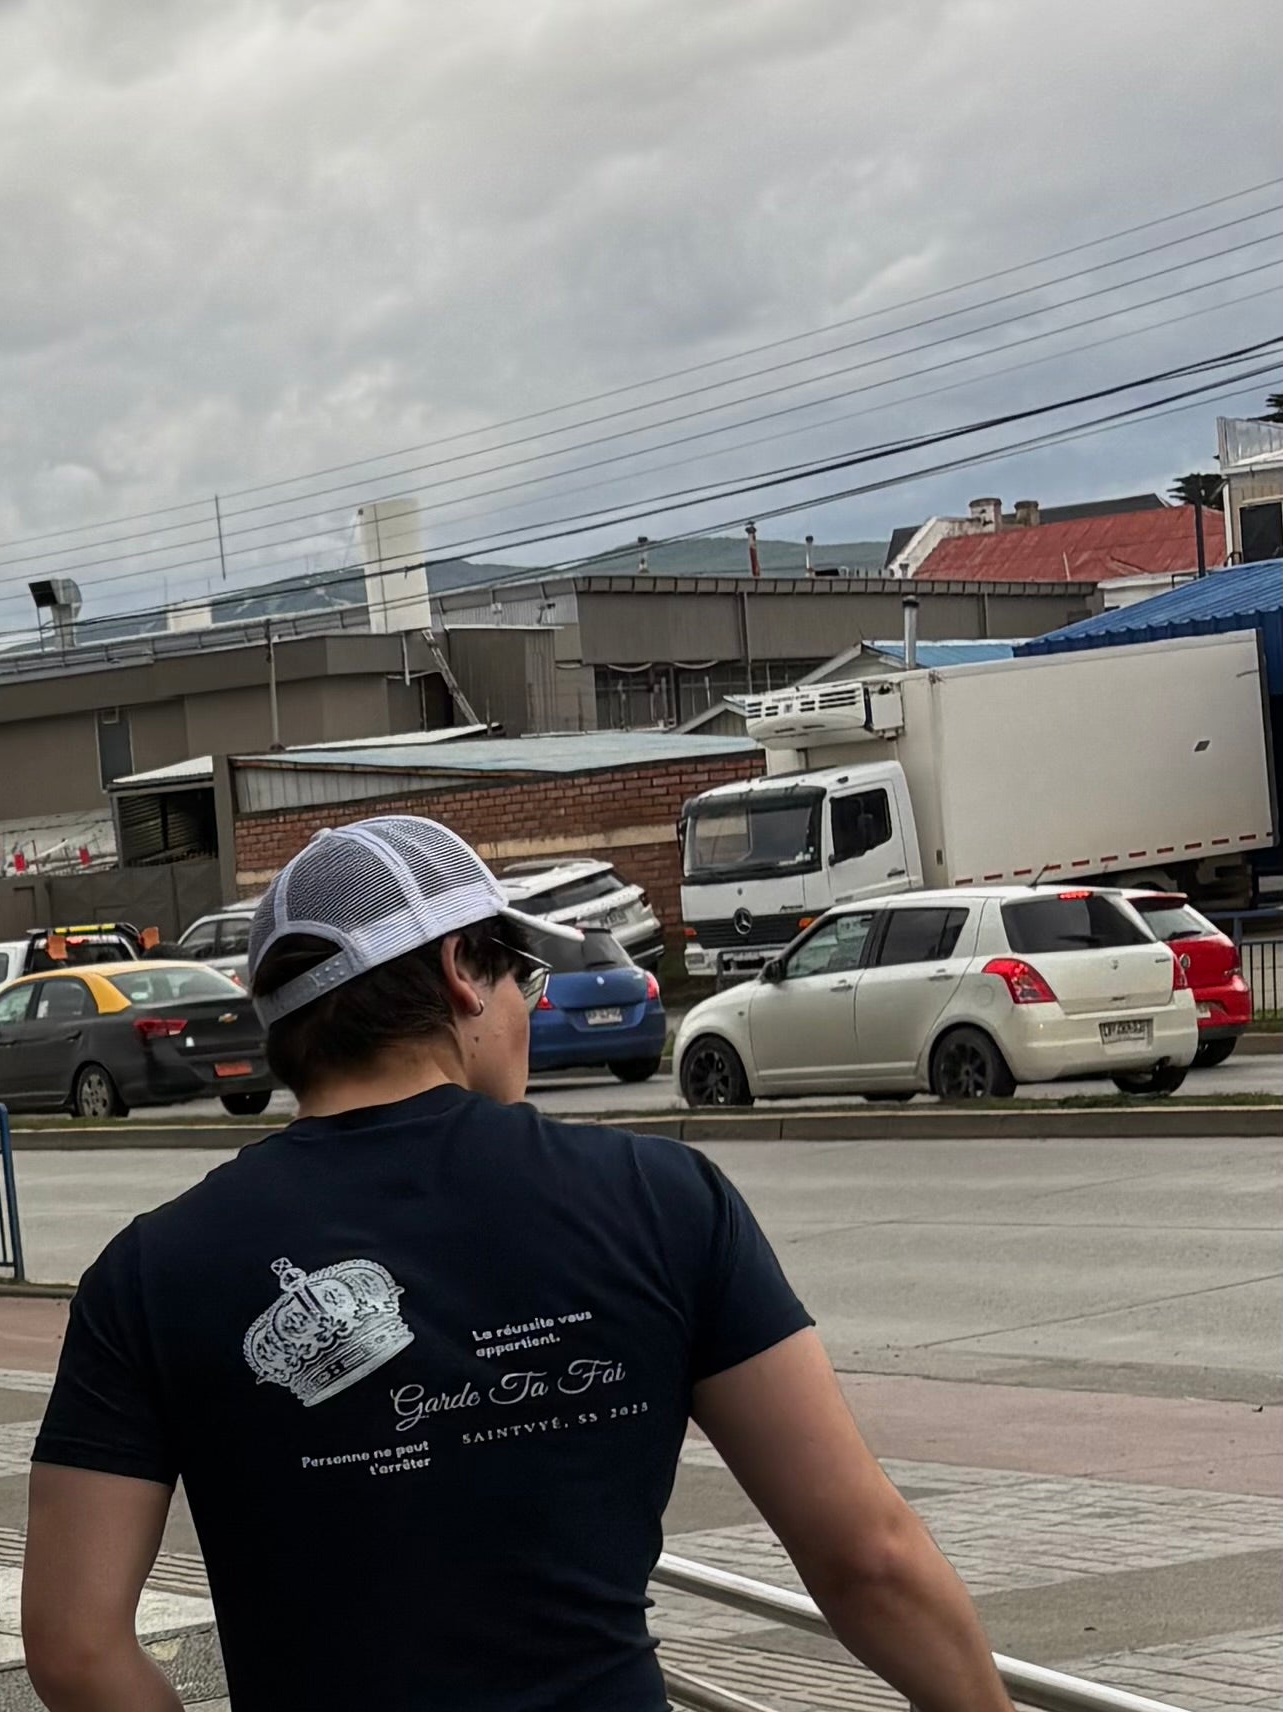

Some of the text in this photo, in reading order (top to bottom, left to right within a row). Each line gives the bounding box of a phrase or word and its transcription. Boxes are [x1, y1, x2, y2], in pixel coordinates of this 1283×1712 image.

[472, 1310, 593, 1342] La réussite vous
[475, 1332, 561, 1359] appartient.
[390, 1359, 626, 1432] Garde Ta Foi
[578, 1412, 598, 1425] SS
[301, 1440, 430, 1469] Personne ne peut
[369, 1456, 432, 1476] t'arrêter
